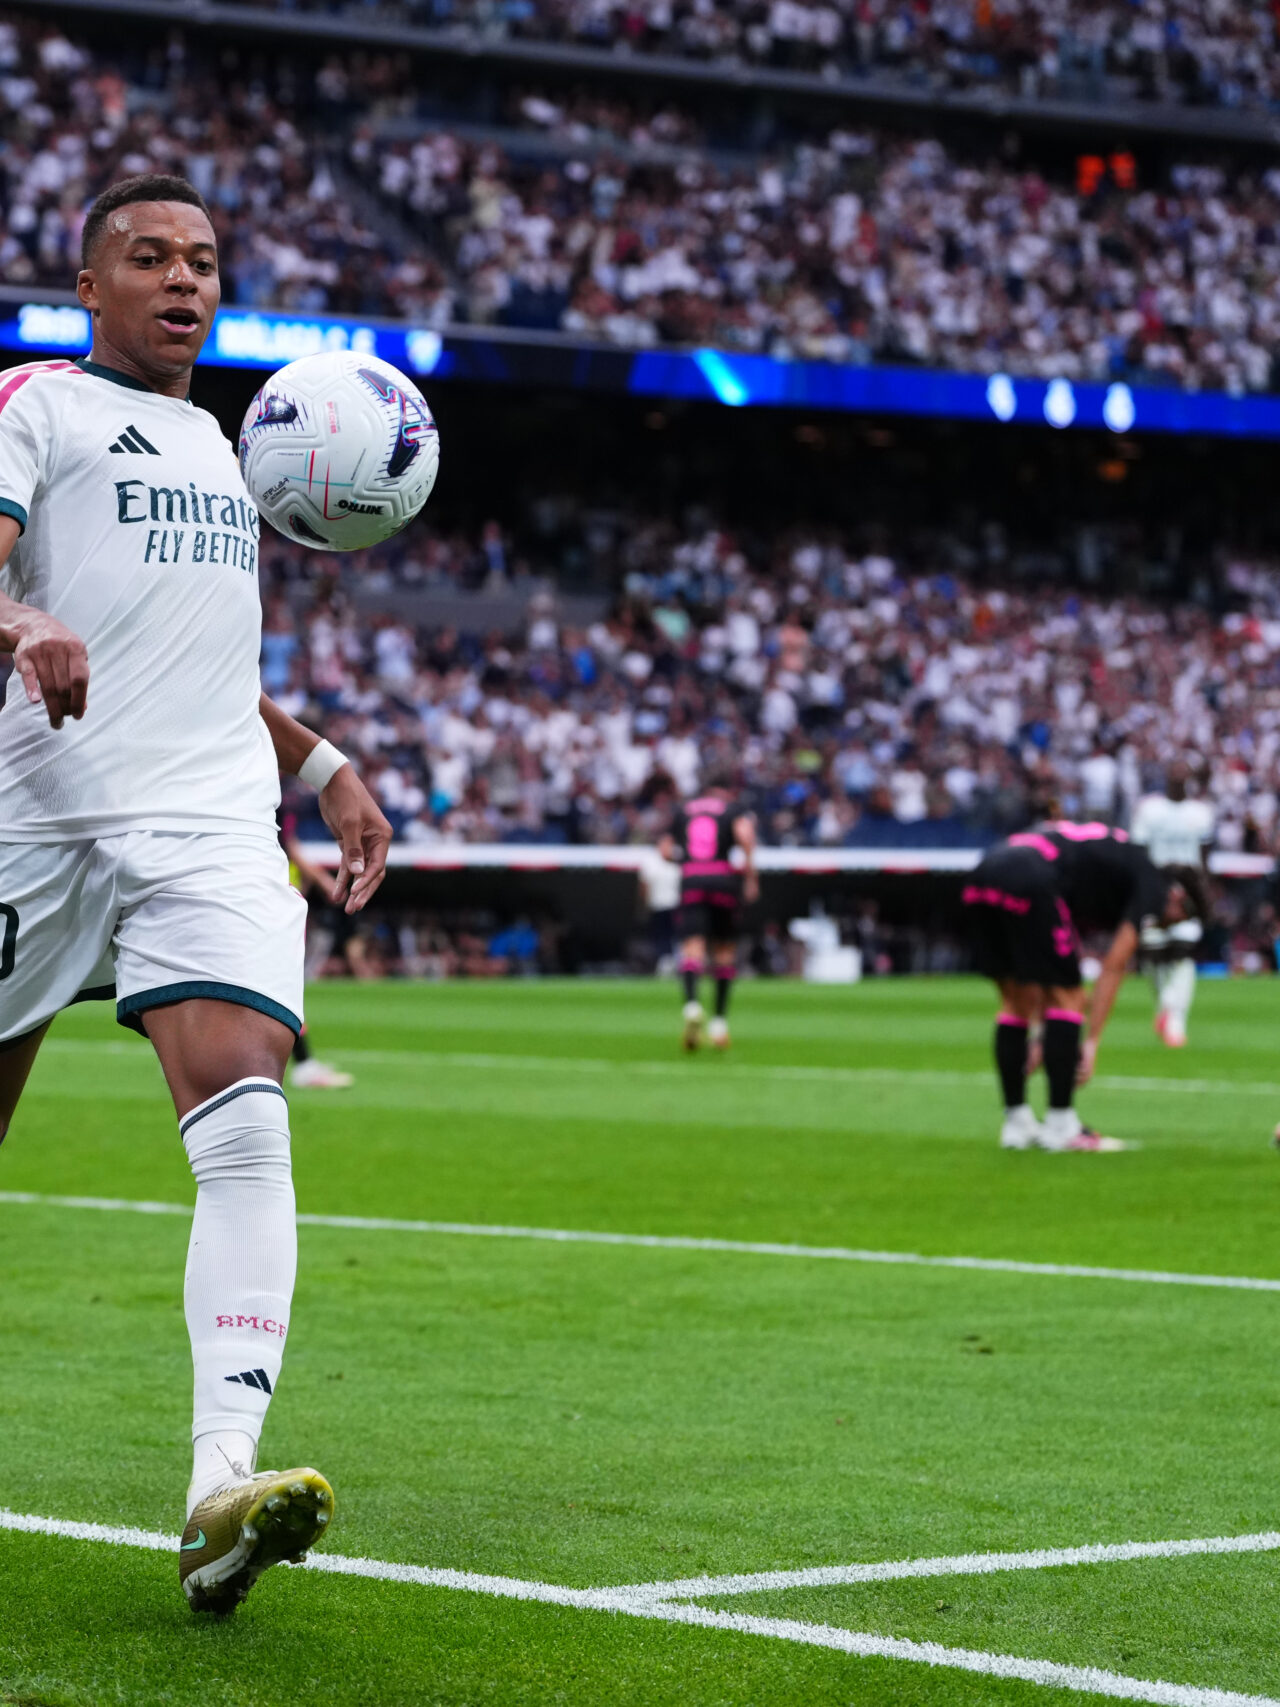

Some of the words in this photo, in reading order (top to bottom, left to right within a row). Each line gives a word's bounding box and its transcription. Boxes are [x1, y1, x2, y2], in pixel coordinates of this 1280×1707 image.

[114, 480, 259, 540] Emirate
[144, 530, 184, 563] FLY
[192, 530, 256, 575] BETTER
